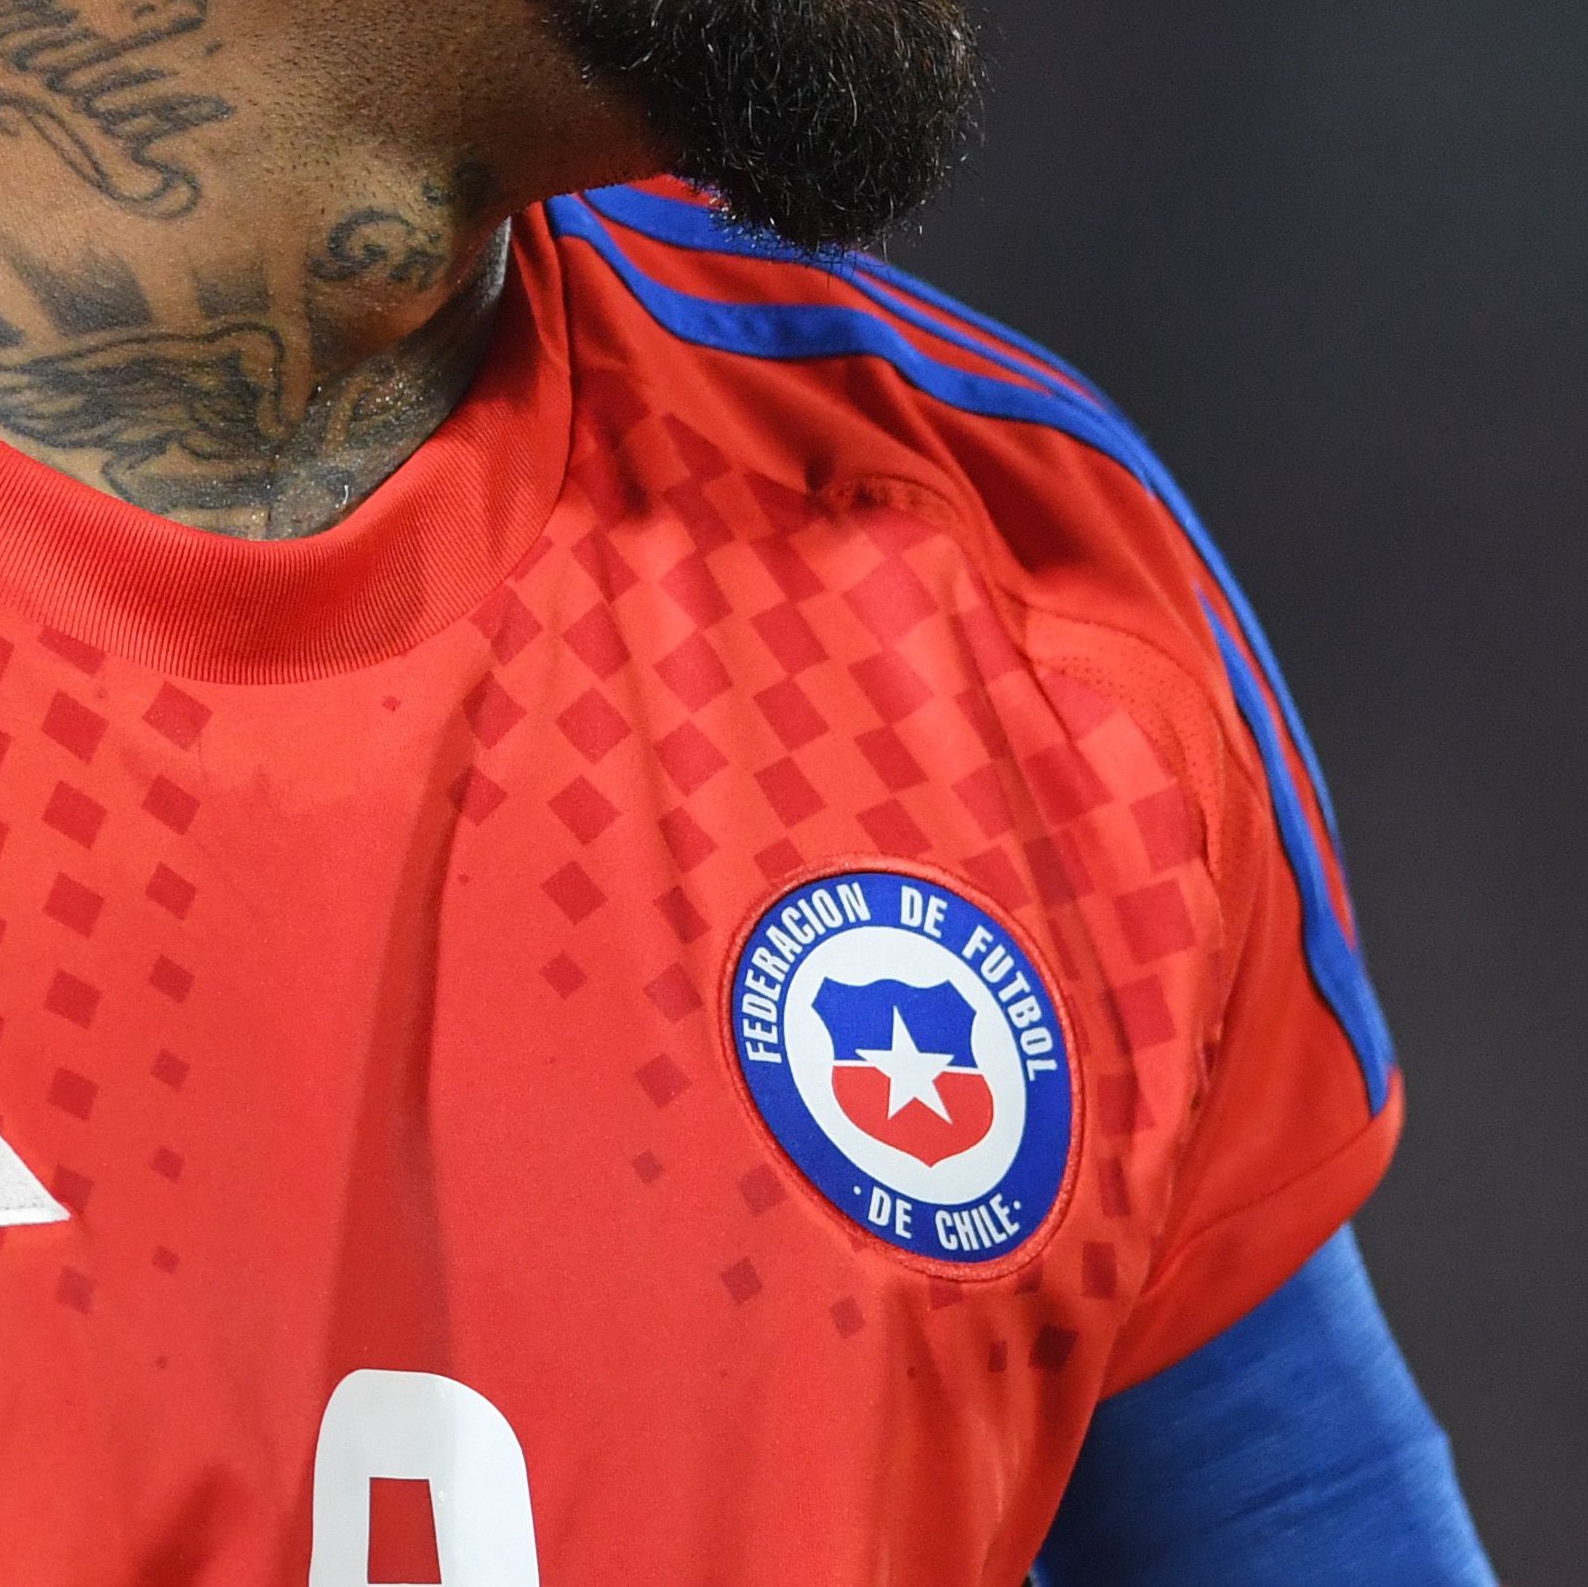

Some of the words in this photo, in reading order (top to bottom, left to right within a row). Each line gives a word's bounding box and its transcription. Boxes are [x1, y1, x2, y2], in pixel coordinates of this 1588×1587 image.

[742, 881, 872, 1064] FEDERACION
[899, 884, 949, 939] DE
[961, 924, 1059, 1082] FUTBOL
[867, 1185, 913, 1240] DE
[934, 1193, 1021, 1252] CHILE
